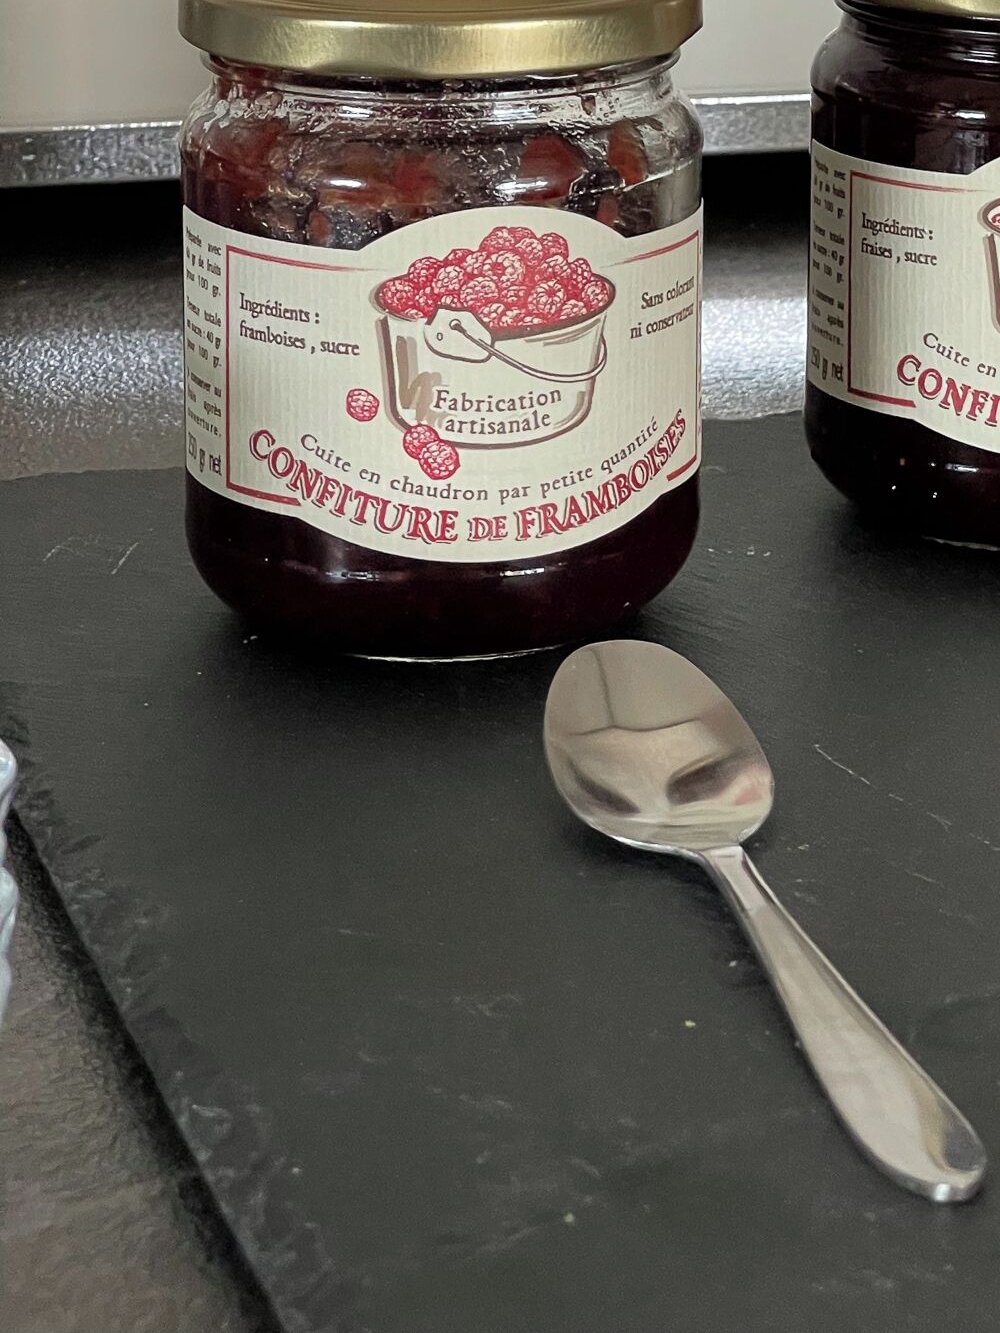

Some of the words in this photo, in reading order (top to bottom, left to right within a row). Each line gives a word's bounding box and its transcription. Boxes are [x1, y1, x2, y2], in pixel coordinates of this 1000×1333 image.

[861, 212, 925, 239] Ingrédients
[861, 237, 892, 258] fraises
[903, 250, 938, 266] sucre
[240, 292, 310, 323] Ingrédients
[641, 292, 664, 310] Sans
[240, 320, 306, 349] framboises
[320, 340, 360, 356] sucre
[630, 322, 642, 339] ni
[923, 332, 970, 367] Cuite
[977, 362, 997, 378] en
[433, 389, 562, 413] Fabrication
[445, 410, 552, 435] artisanale
[300, 433, 351, 472] Cuite
[359, 469, 380, 484] en
[390, 475, 488, 501] chaudron
[500, 485, 531, 505] par
[540, 467, 593, 498] petite
[601, 416, 658, 474] quantité
[249, 429, 459, 544] CONFITURE
[467, 516, 508, 541] DE
[514, 408, 686, 542] FRAMBOISES
